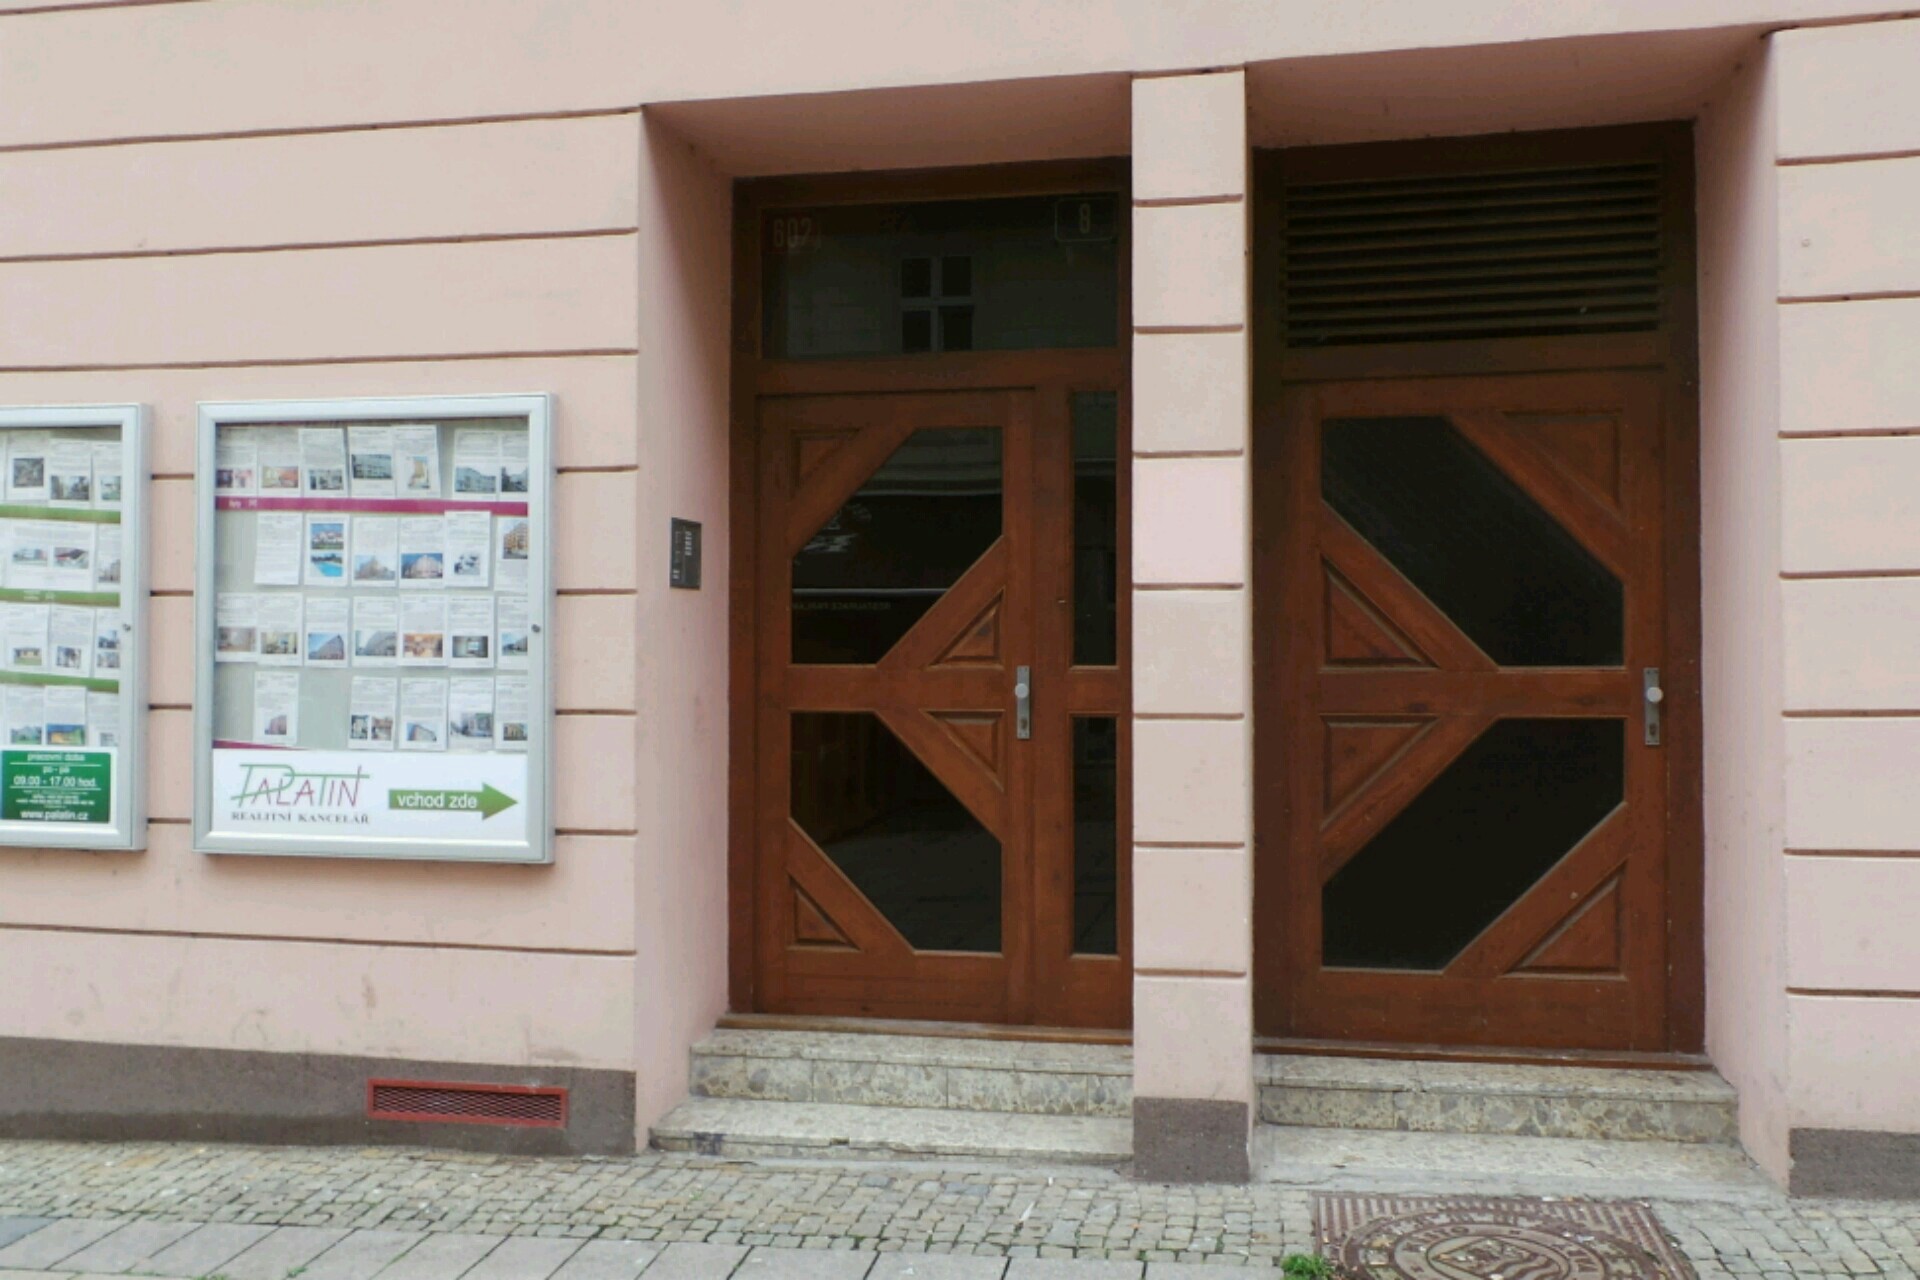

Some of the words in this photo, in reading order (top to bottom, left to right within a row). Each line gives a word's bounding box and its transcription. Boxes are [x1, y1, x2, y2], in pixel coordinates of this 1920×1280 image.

[1080, 203, 1092, 234] 8
[772, 217, 813, 249] 602
[230, 763, 370, 808] PALATIN
[396, 791, 445, 808] vchod
[448, 793, 478, 809] zde
[20, 811, 89, 821] www.palatin.cz
[231, 811, 292, 822] REALITNÍ
[298, 812, 370, 825] KANCELÁŘ
